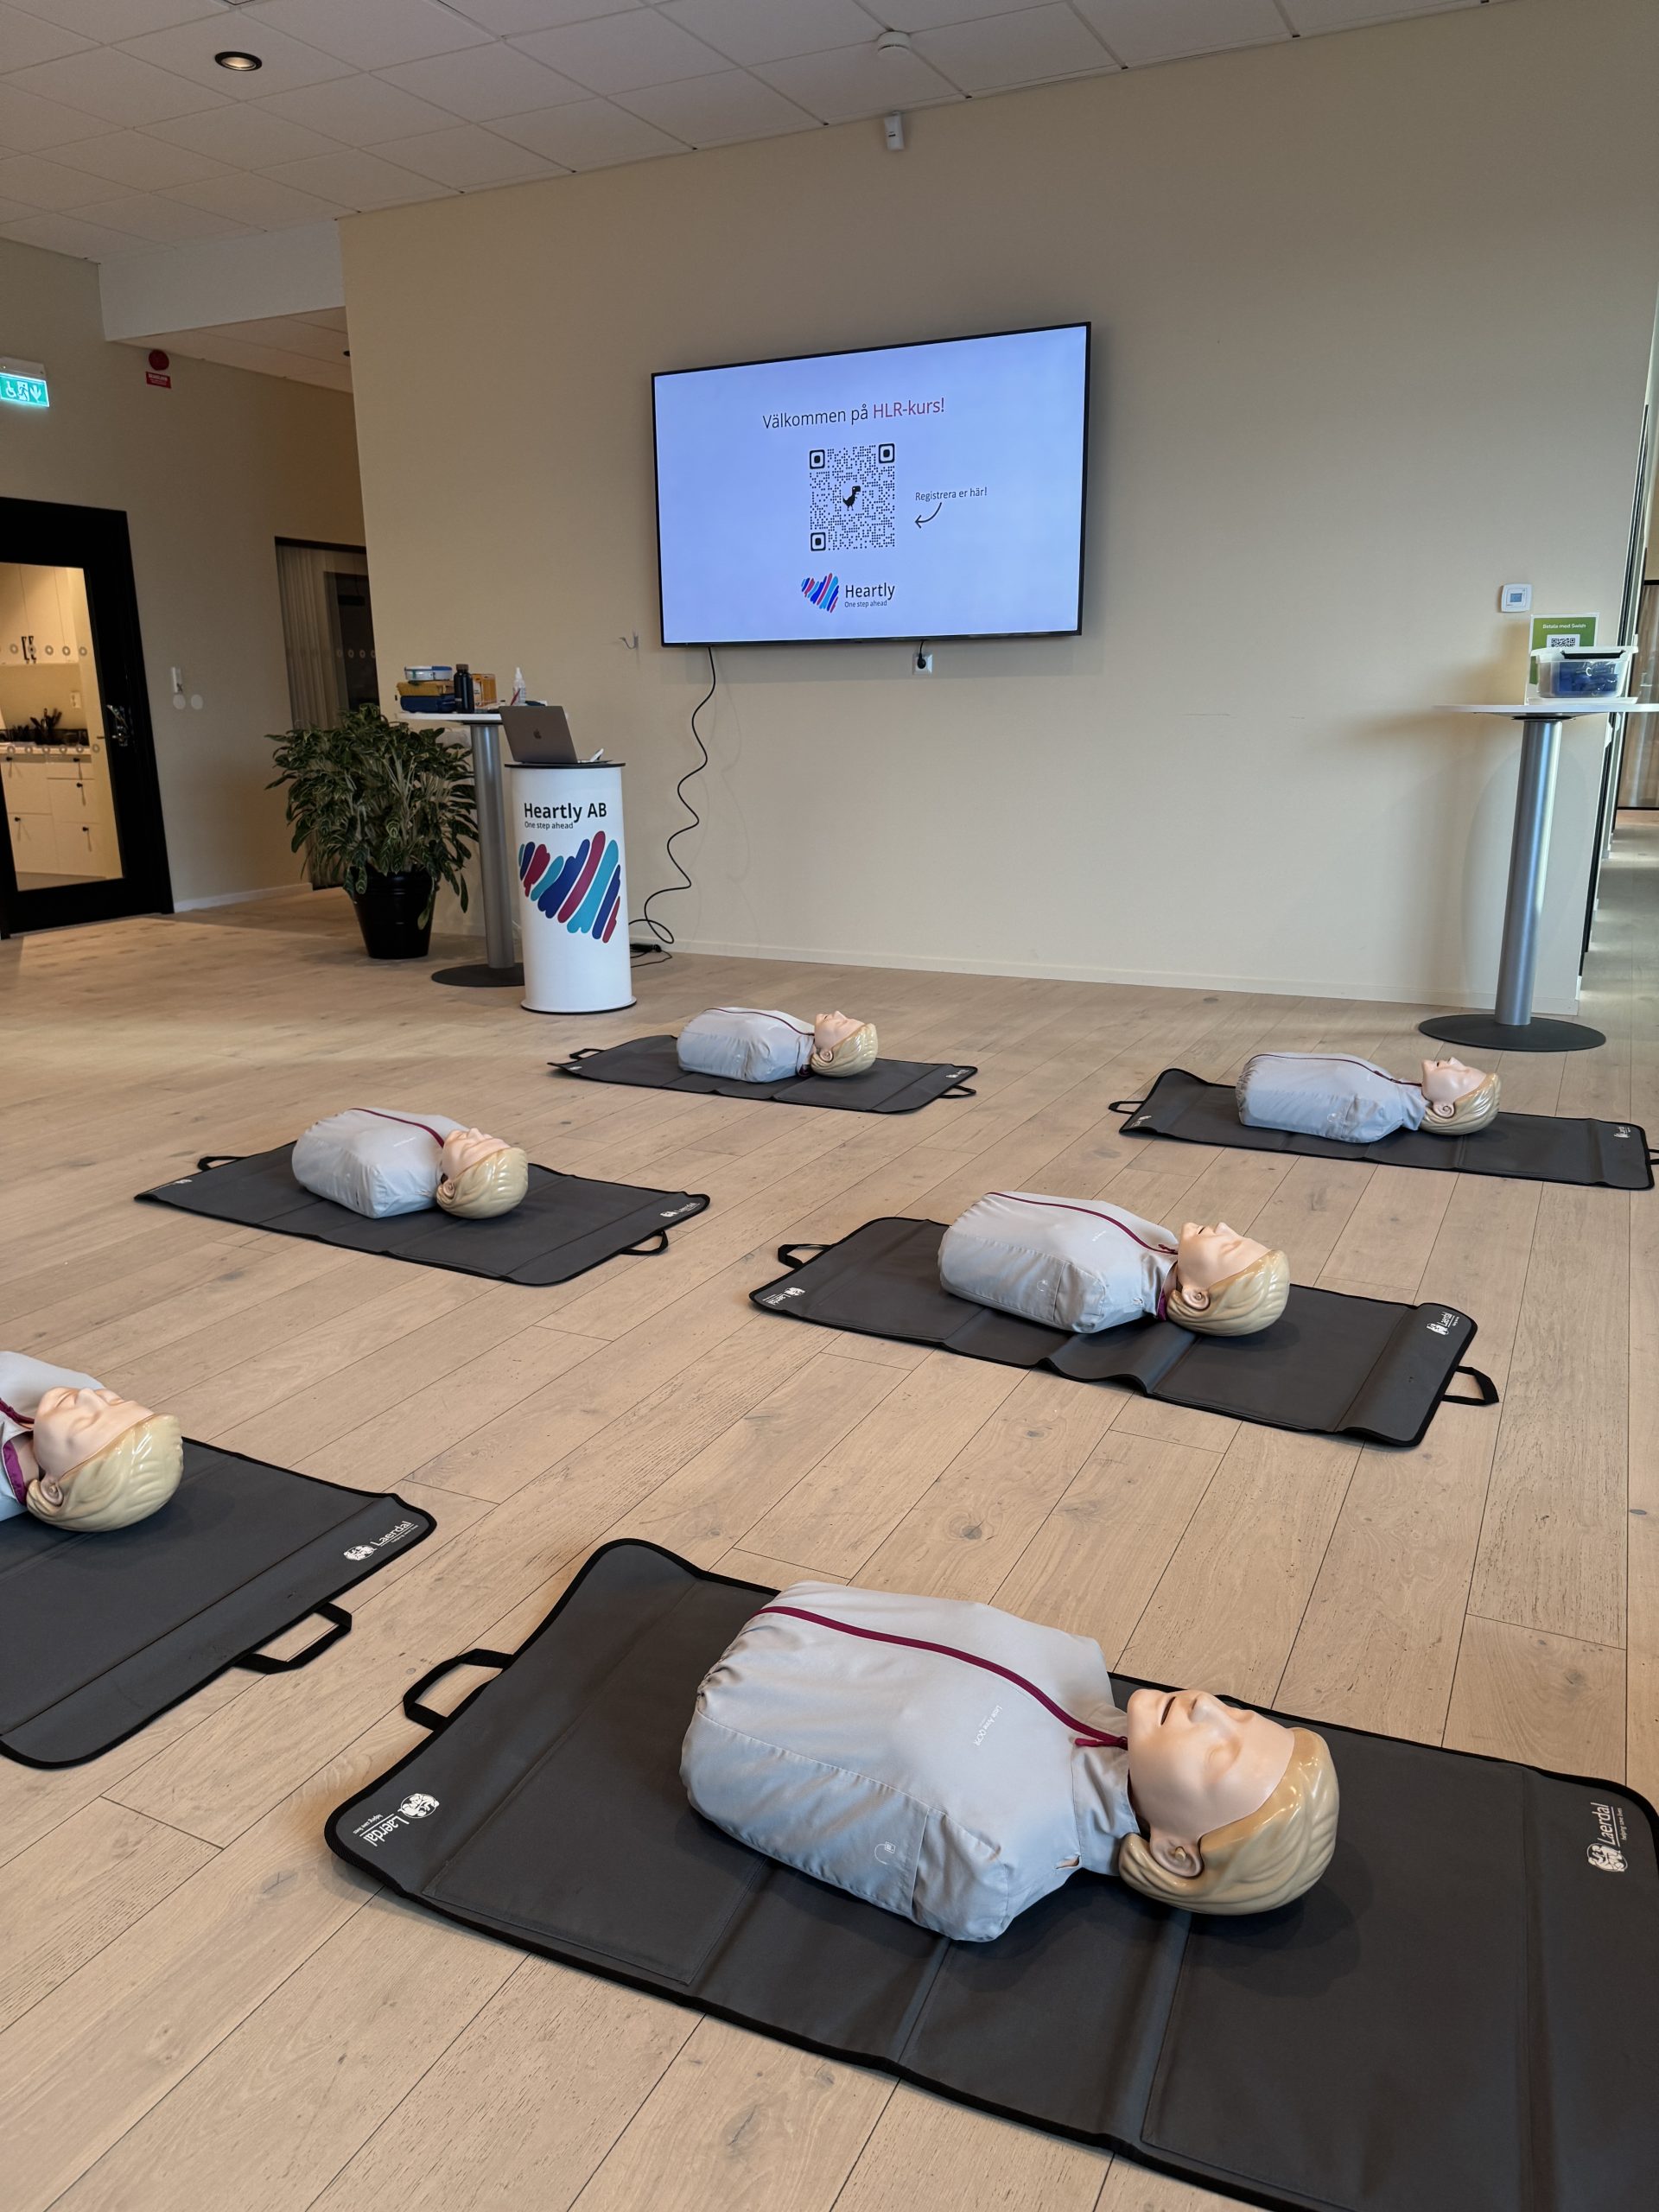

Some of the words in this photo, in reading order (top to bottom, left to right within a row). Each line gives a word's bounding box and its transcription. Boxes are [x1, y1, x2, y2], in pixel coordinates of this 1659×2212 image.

[763, 410, 846, 429] Välkommen
[851, 404, 868, 425] på
[873, 397, 945, 419] HLR-kurs!
[915, 492, 957, 502] Registrera
[969, 486, 988, 497] här!
[845, 582, 895, 601] Heartly
[524, 803, 582, 823] Heartly
[587, 802, 607, 818] AB
[536, 822, 550, 830] step
[370, 1520, 412, 1547] Laerdal
[363, 1815, 410, 1847] Laerdal
[1590, 1802, 1617, 1846] Laerdal
